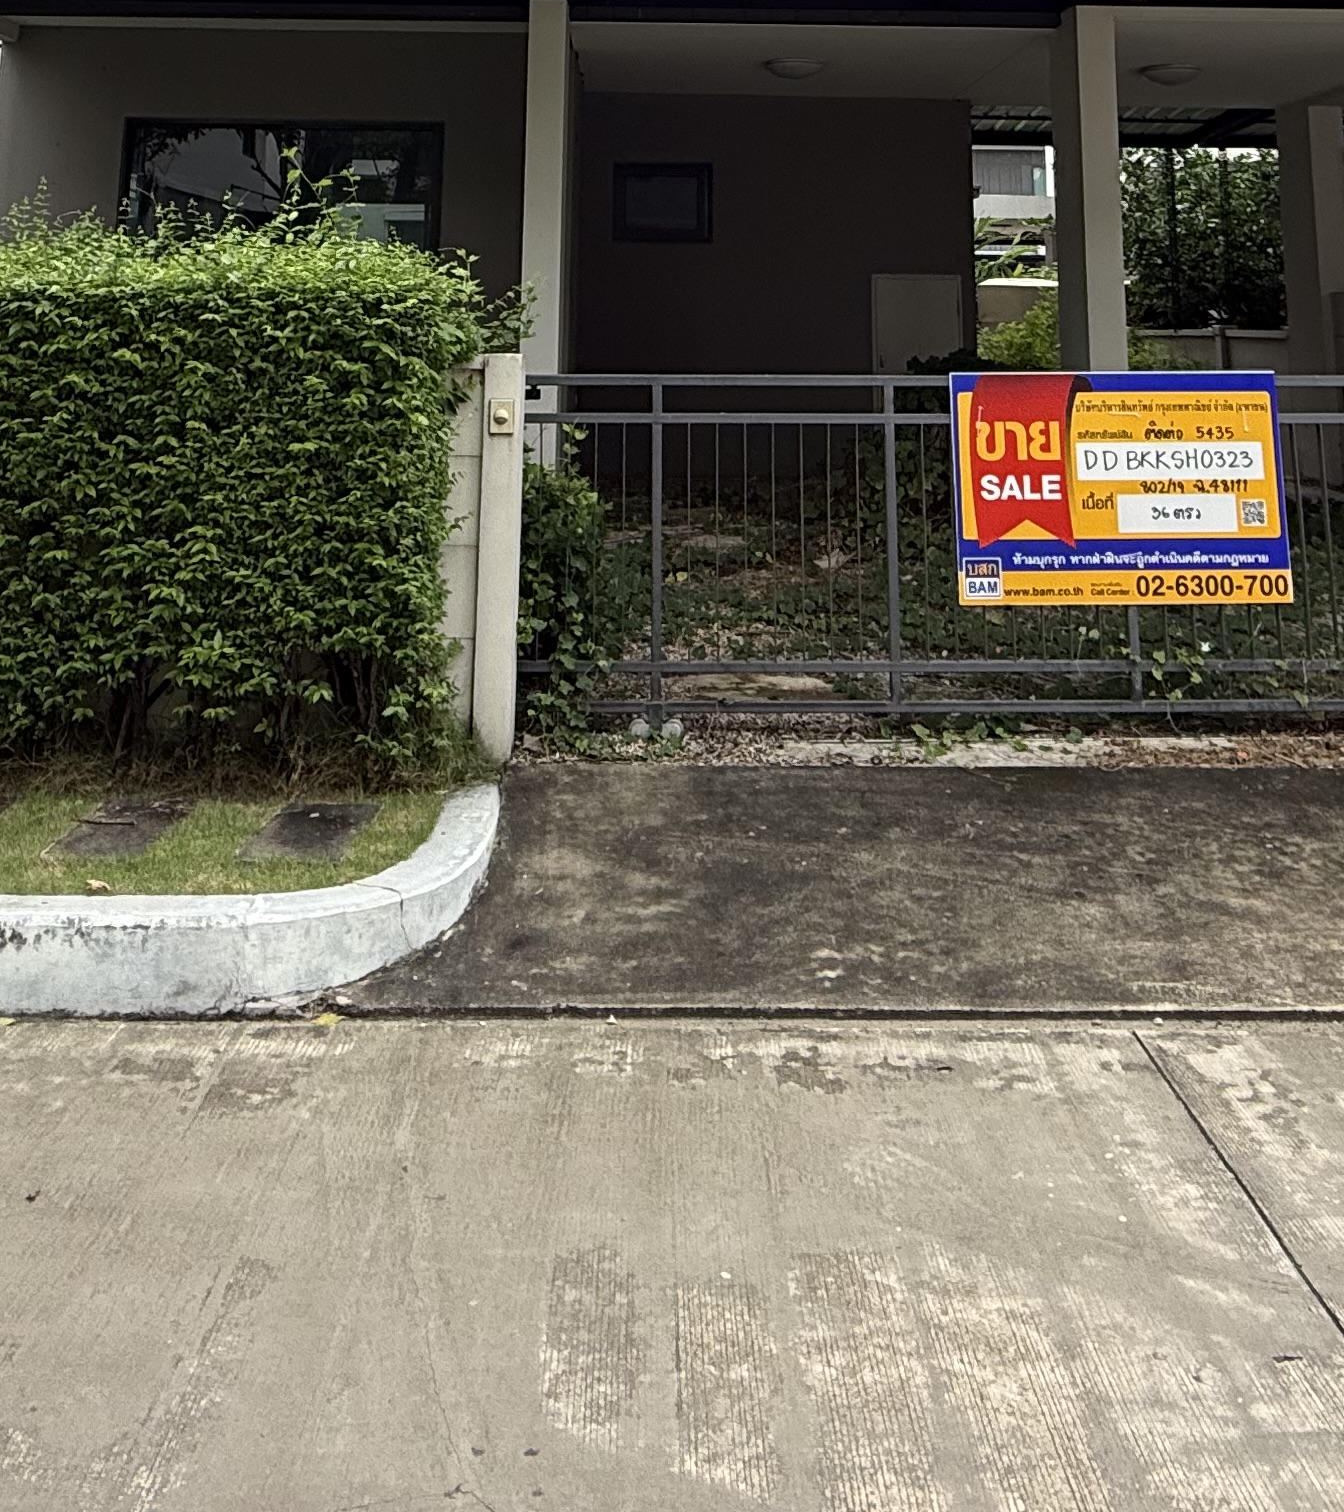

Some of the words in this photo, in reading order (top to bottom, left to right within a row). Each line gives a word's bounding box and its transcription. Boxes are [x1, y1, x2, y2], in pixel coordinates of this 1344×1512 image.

[1196, 426, 1235, 440] 5435
[975, 421, 1062, 462] ขาย
[980, 474, 1063, 501] SALE
[1139, 478, 1185, 494] 802/19
[1082, 491, 1114, 510] เนื้อที่
[1012, 552, 1067, 569] ห้ามบุกรุก
[967, 563, 998, 576] บสก
[968, 581, 998, 594] BAM
[1004, 587, 1084, 597] www.bam.co.th
[1090, 588, 1105, 596] Call
[1136, 575, 1289, 597] 02-6300-700
